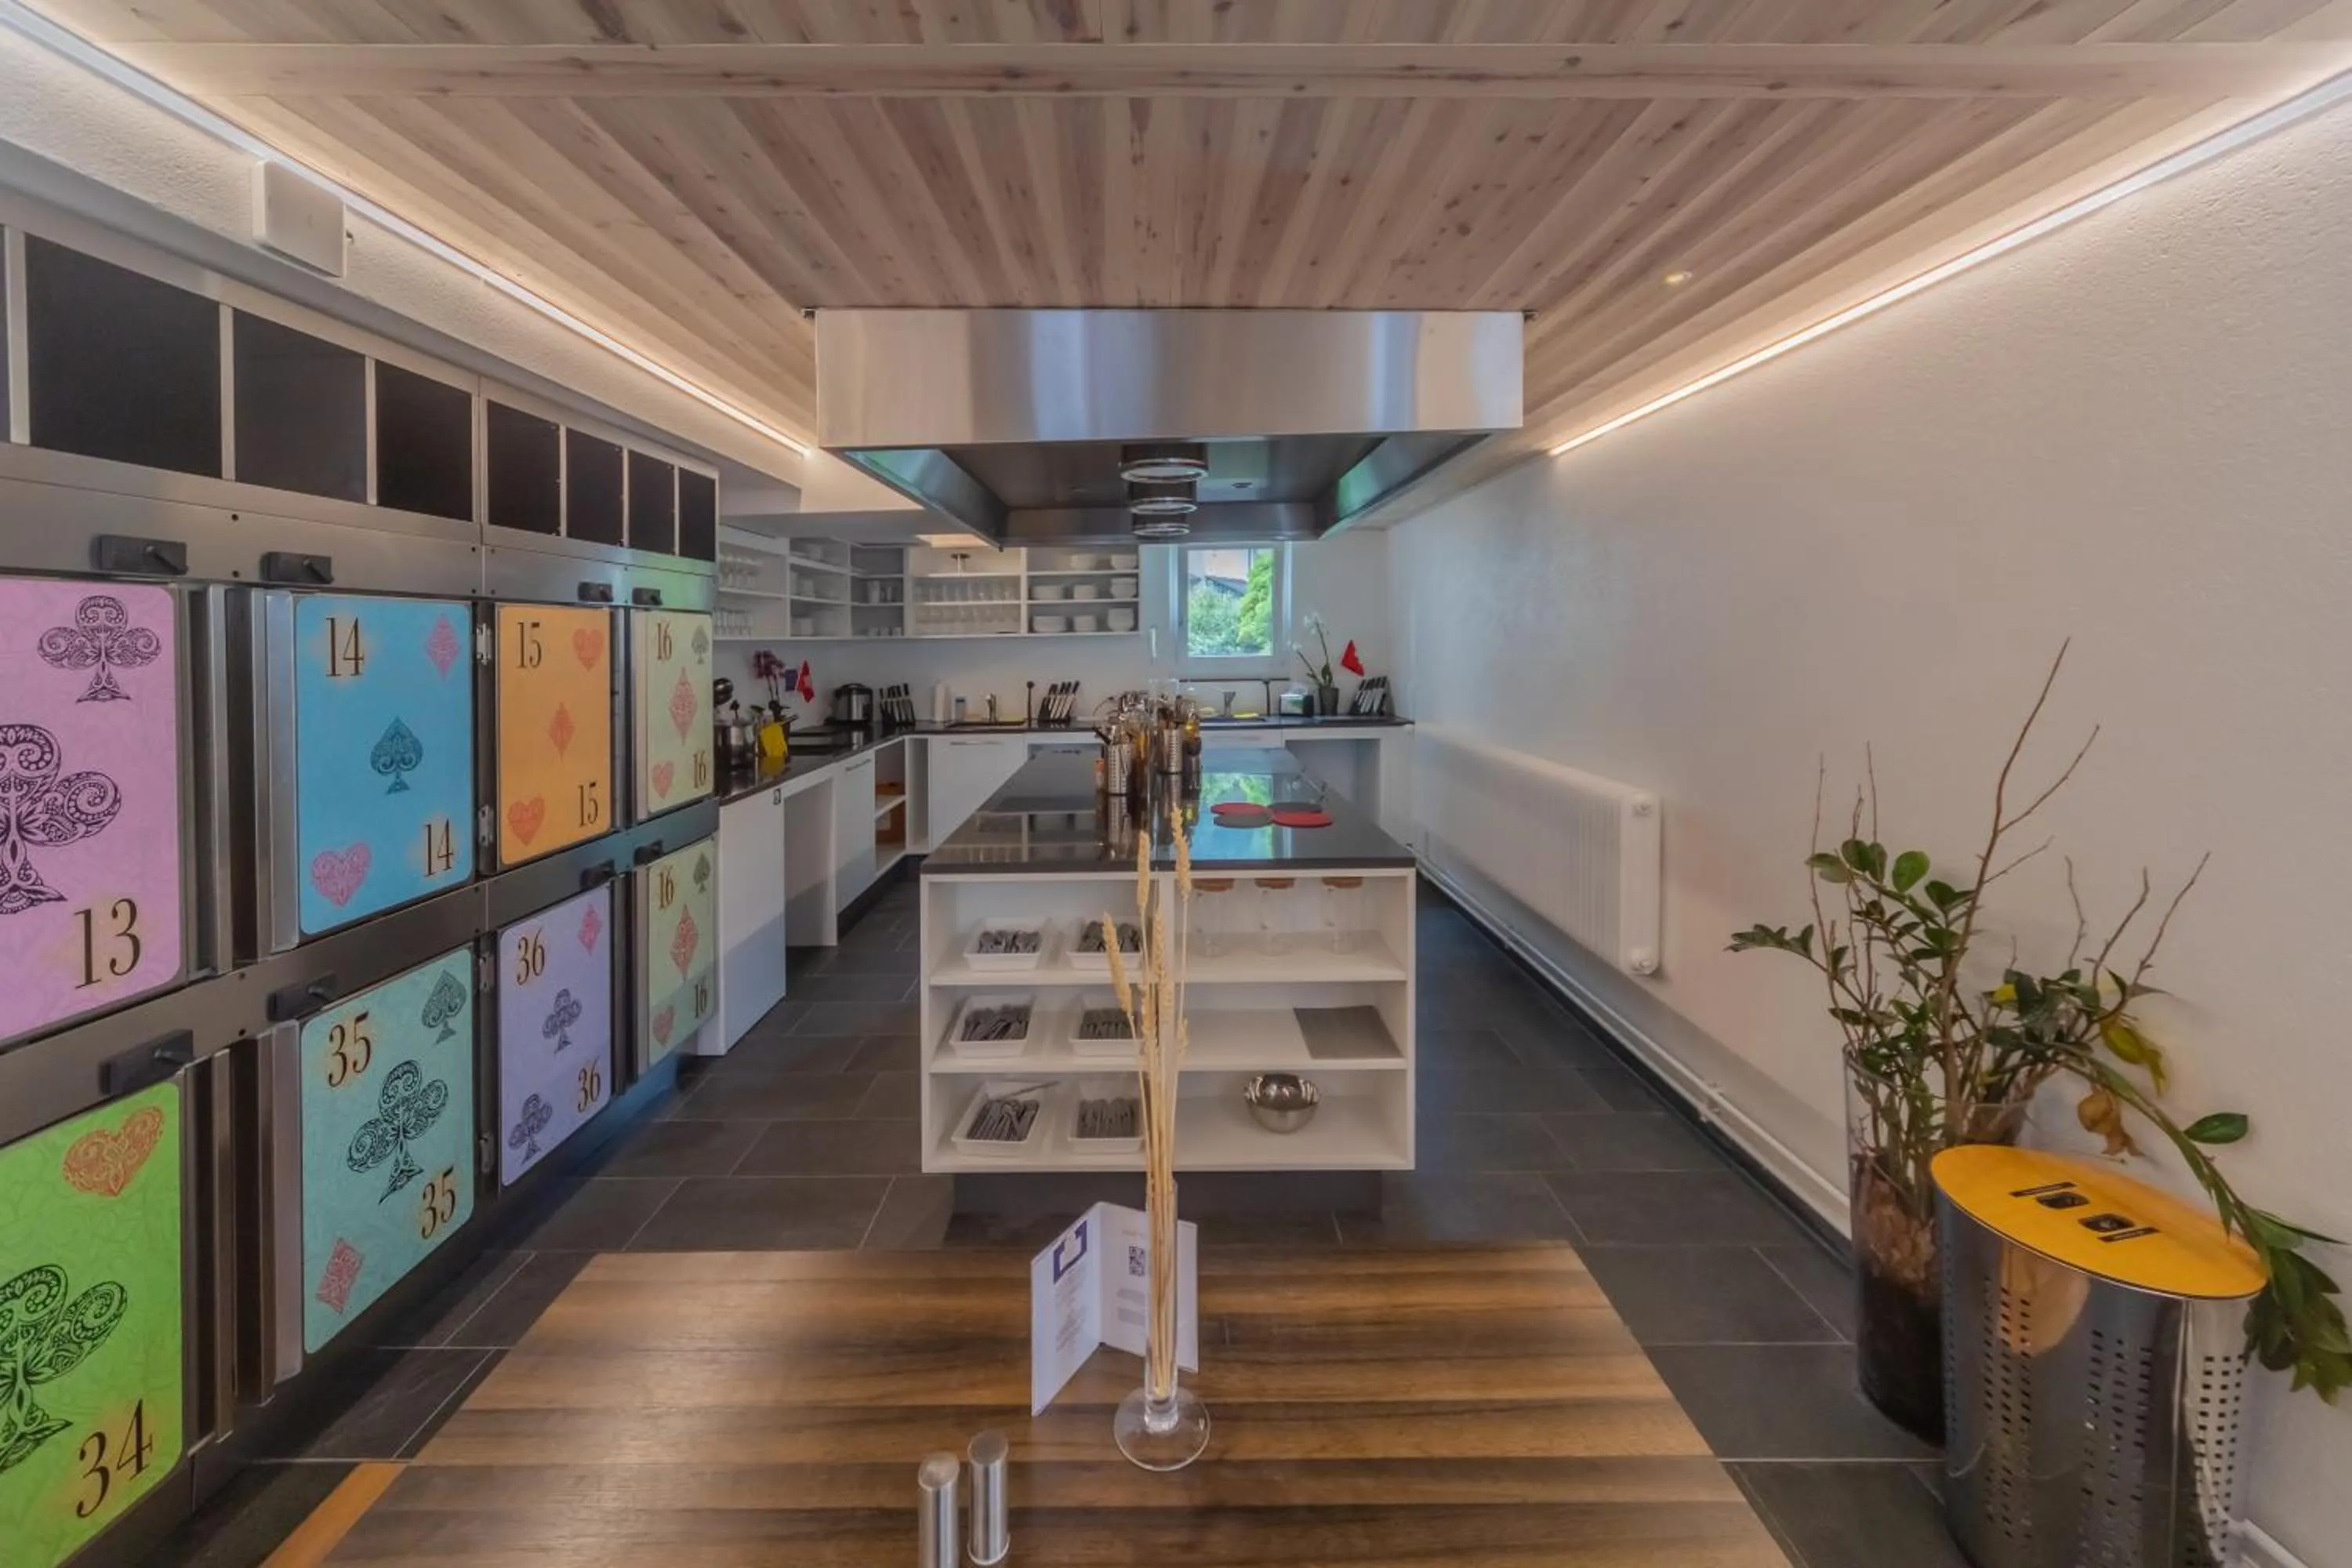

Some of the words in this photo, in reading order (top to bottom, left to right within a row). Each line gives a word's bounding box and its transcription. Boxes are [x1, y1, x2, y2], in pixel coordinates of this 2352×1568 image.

[325, 616, 365, 678] 14
[517, 620, 543, 670] 15
[656, 622, 673, 661] 16
[693, 750, 706, 789] 16
[579, 781, 599, 827] 15
[423, 818, 455, 879] 14
[657, 864, 674, 909] 16
[73, 898, 142, 990] 13
[517, 929, 546, 985] 36
[694, 975, 708, 1018] 16
[328, 1011, 372, 1088] 35
[576, 1056, 602, 1113] 36
[421, 1166, 456, 1240] 35
[76, 1397, 154, 1519] 34
